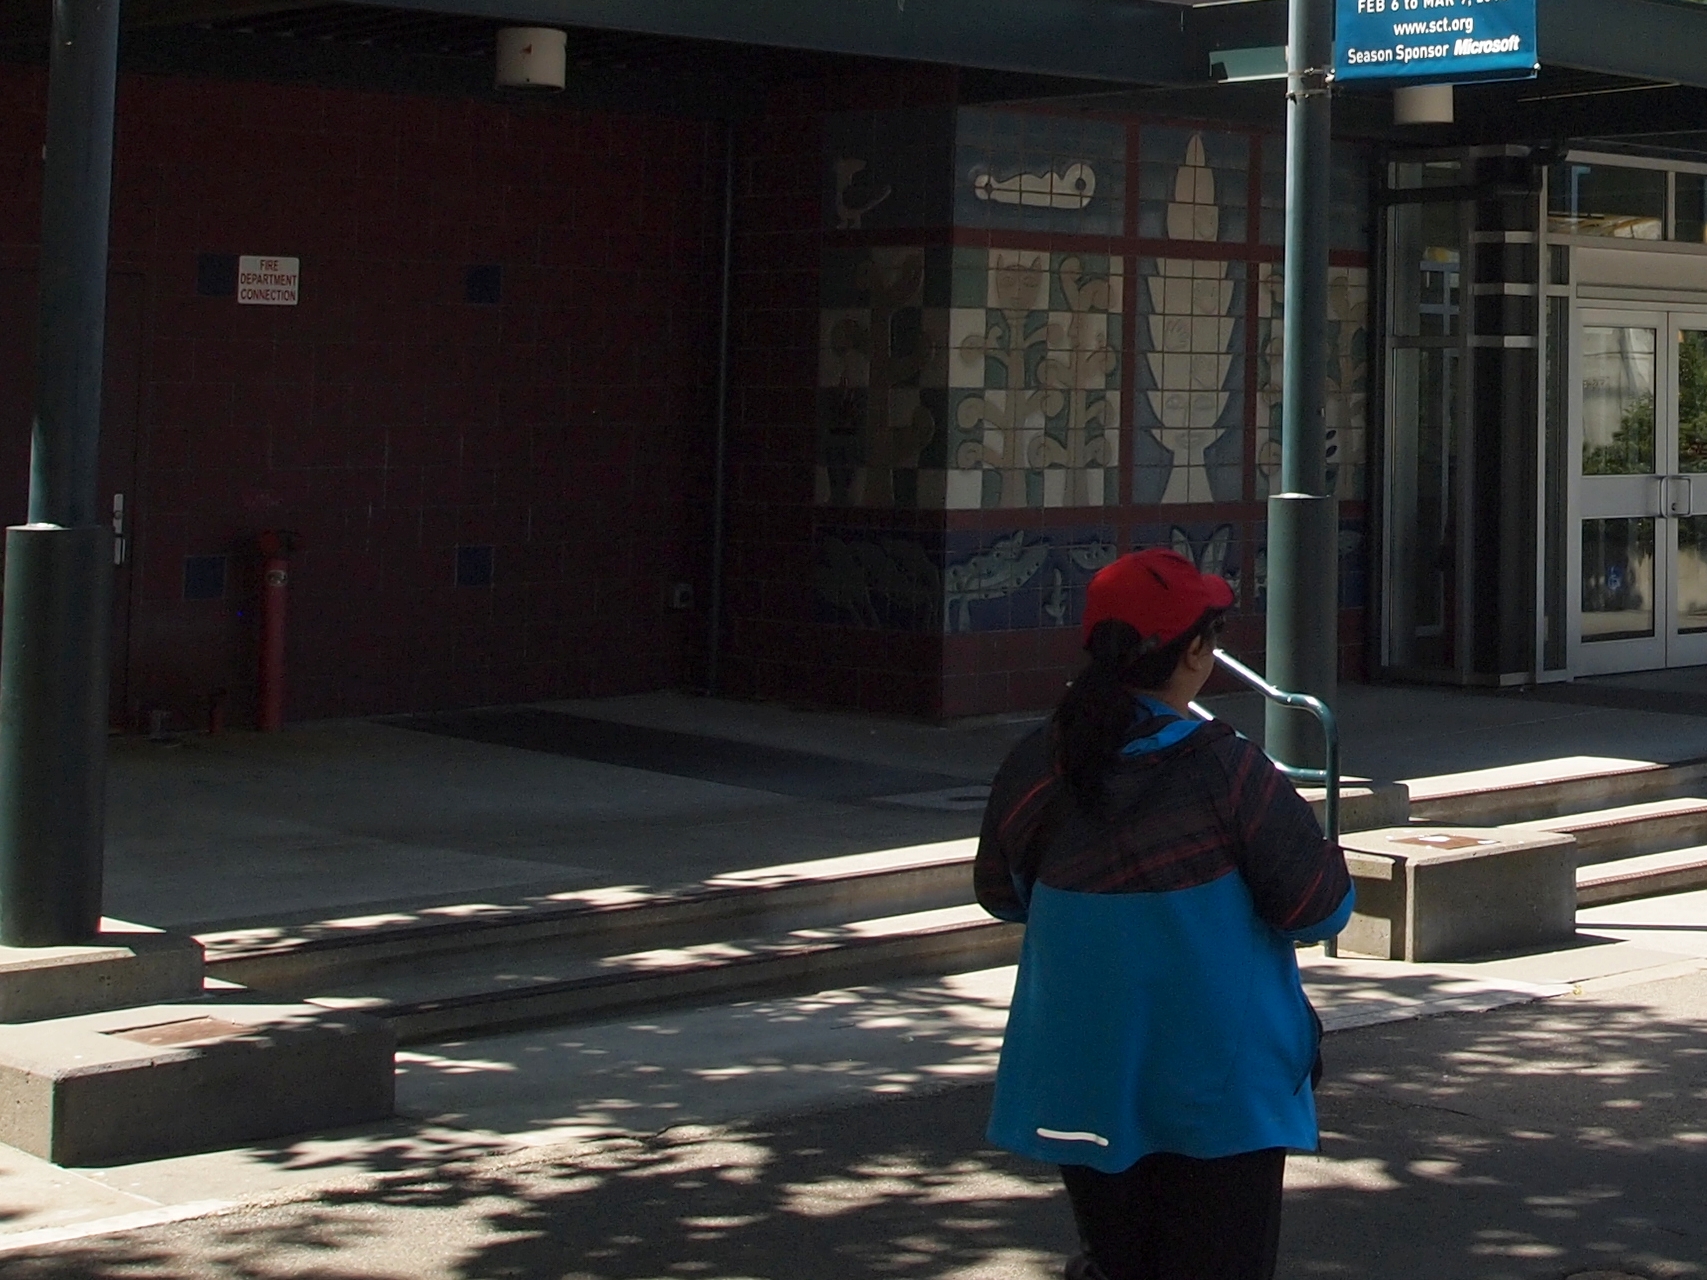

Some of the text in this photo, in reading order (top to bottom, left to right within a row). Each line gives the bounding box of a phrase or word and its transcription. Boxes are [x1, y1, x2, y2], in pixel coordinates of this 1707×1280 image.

[1394, 17, 1473, 35] www.sct.org
[1348, 35, 1521, 64] Season Sponsor Microsoft
[260, 260, 280, 271] FIRE
[240, 273, 297, 286] DEPARTMENT
[240, 289, 296, 301] CONNECTION
